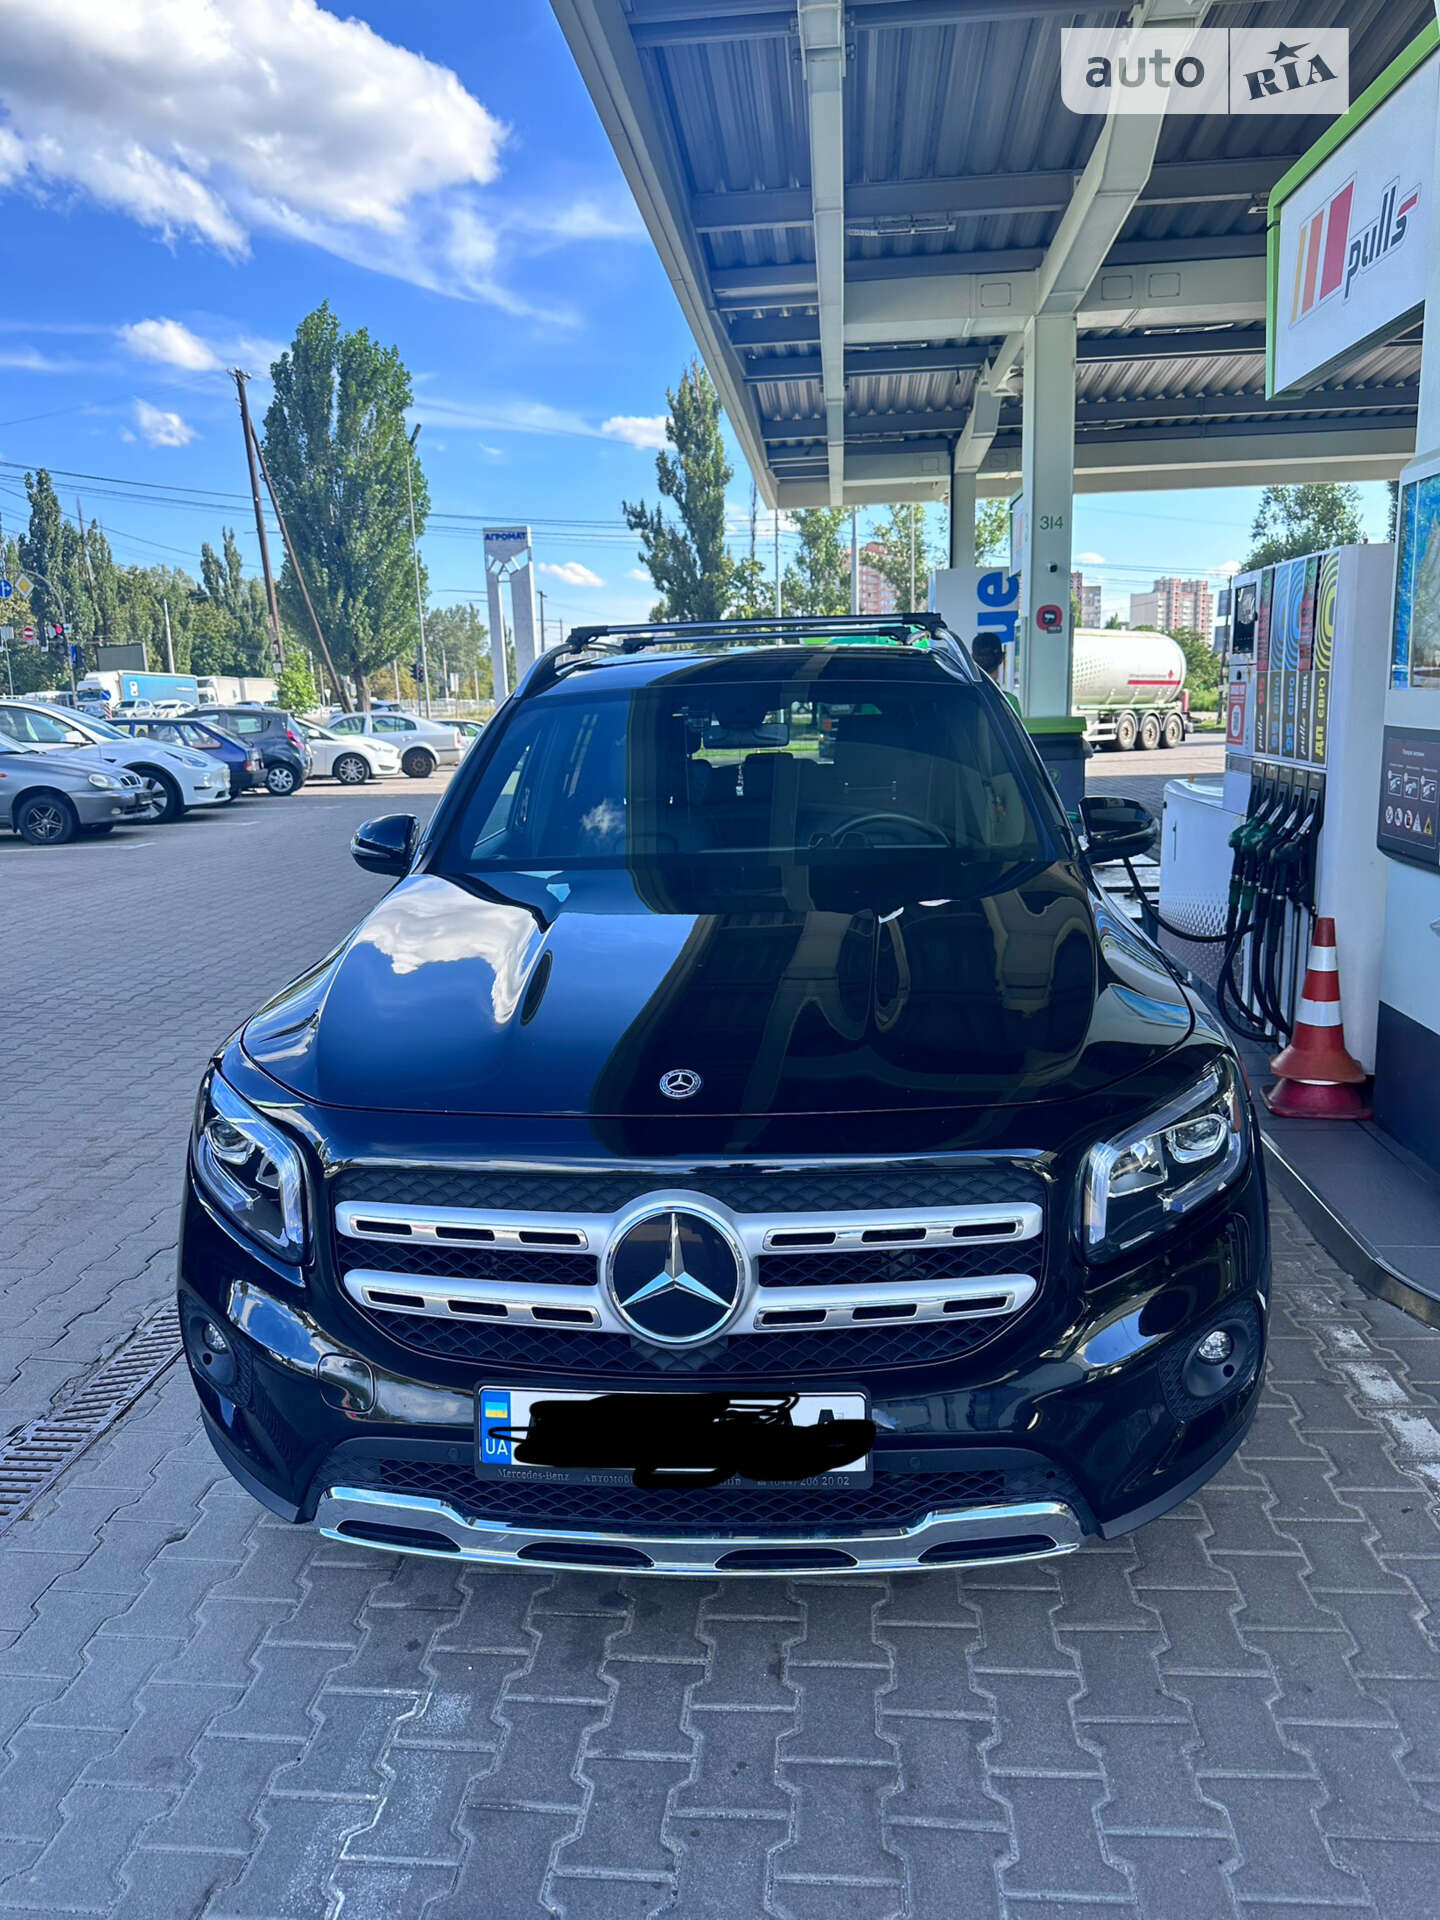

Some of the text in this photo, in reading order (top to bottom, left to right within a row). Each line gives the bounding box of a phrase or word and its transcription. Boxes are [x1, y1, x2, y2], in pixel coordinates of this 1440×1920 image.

[1344, 185, 1419, 299] pulls
[1039, 515, 1064, 531] 314
[485, 1438, 508, 1456] UA
[497, 1468, 570, 1481] Mercedes-Benz
